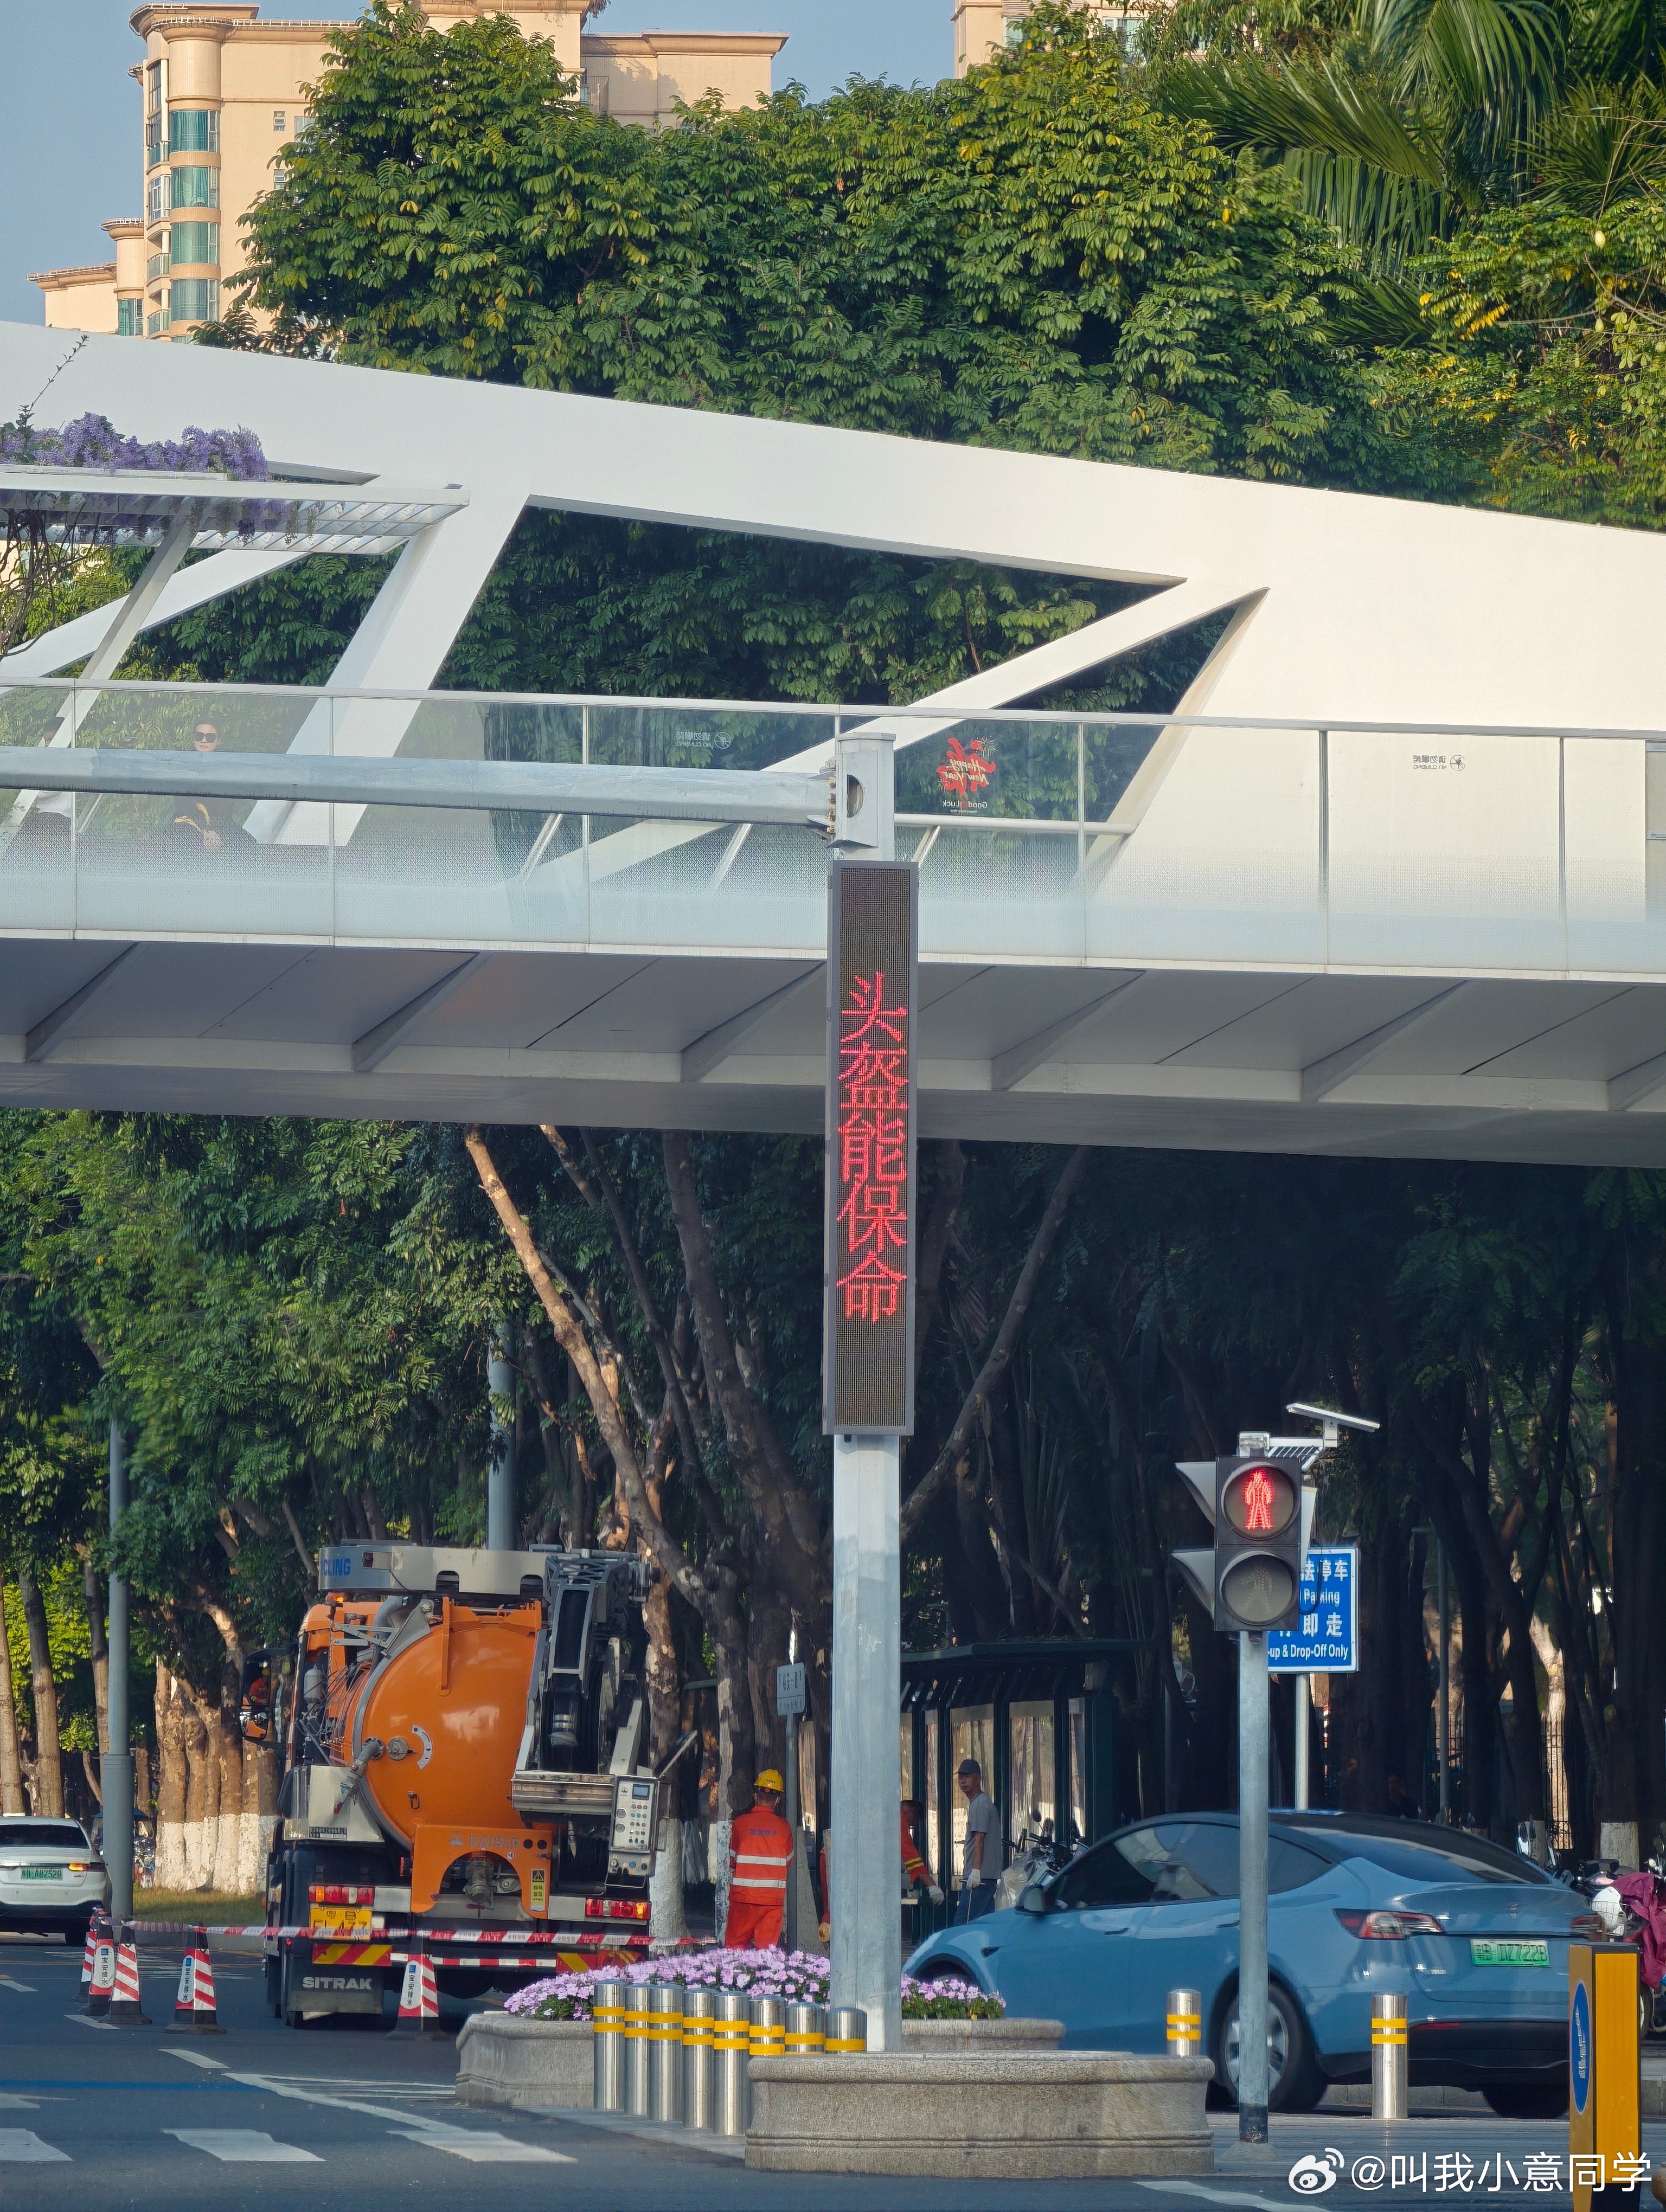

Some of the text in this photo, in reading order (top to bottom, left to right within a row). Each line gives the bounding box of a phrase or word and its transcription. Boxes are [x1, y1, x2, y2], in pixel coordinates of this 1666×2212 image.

[836, 972, 908, 1323] 头盔能保命
[1304, 1589, 1340, 1607] Paking
[1282, 1644, 1289, 1657] &
[1290, 1644, 1327, 1661] Drop-Off
[1329, 1644, 1348, 1661] Only
[470, 1835, 521, 1849] KAISER
[302, 1977, 373, 1990] SITRAK
